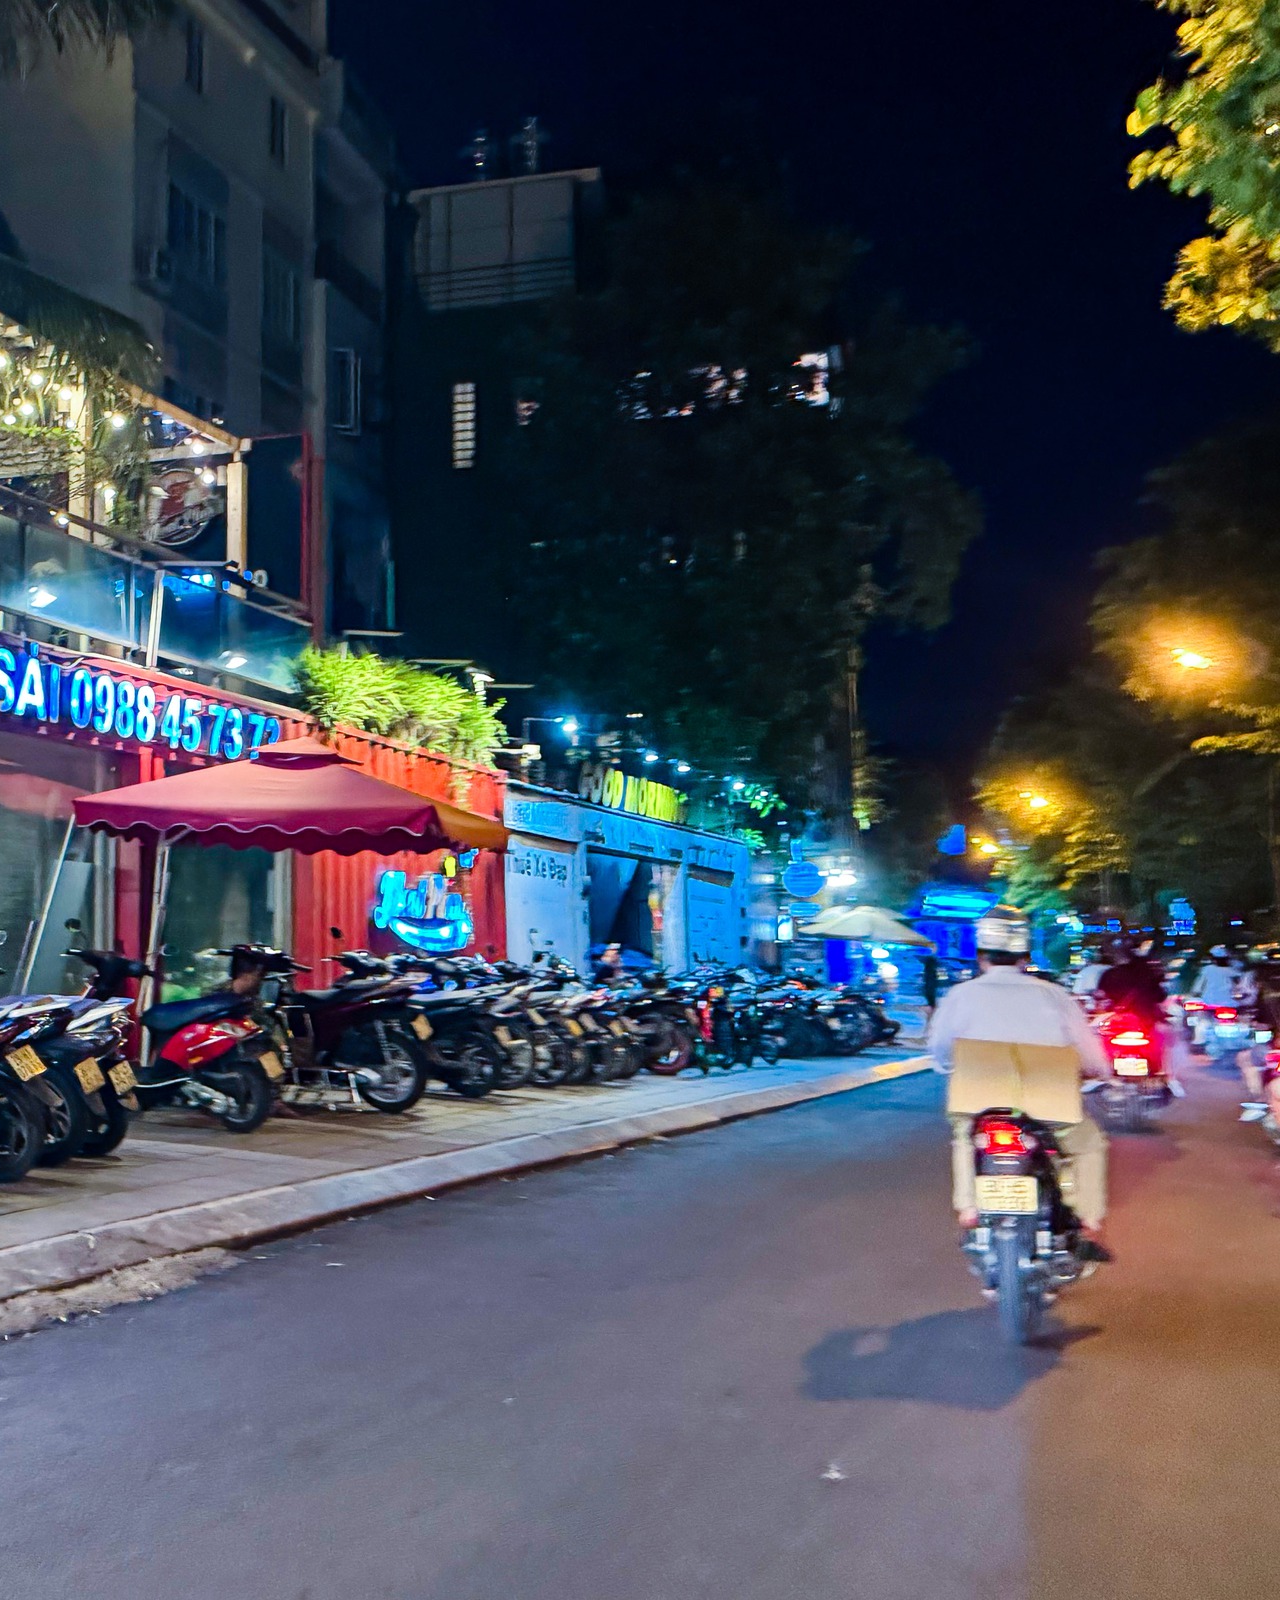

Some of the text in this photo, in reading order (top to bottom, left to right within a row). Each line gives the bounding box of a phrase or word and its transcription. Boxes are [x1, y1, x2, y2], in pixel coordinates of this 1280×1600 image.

[70, 668, 156, 742] 0988
[161, 694, 202, 753] 45
[208, 704, 243, 760] 73
